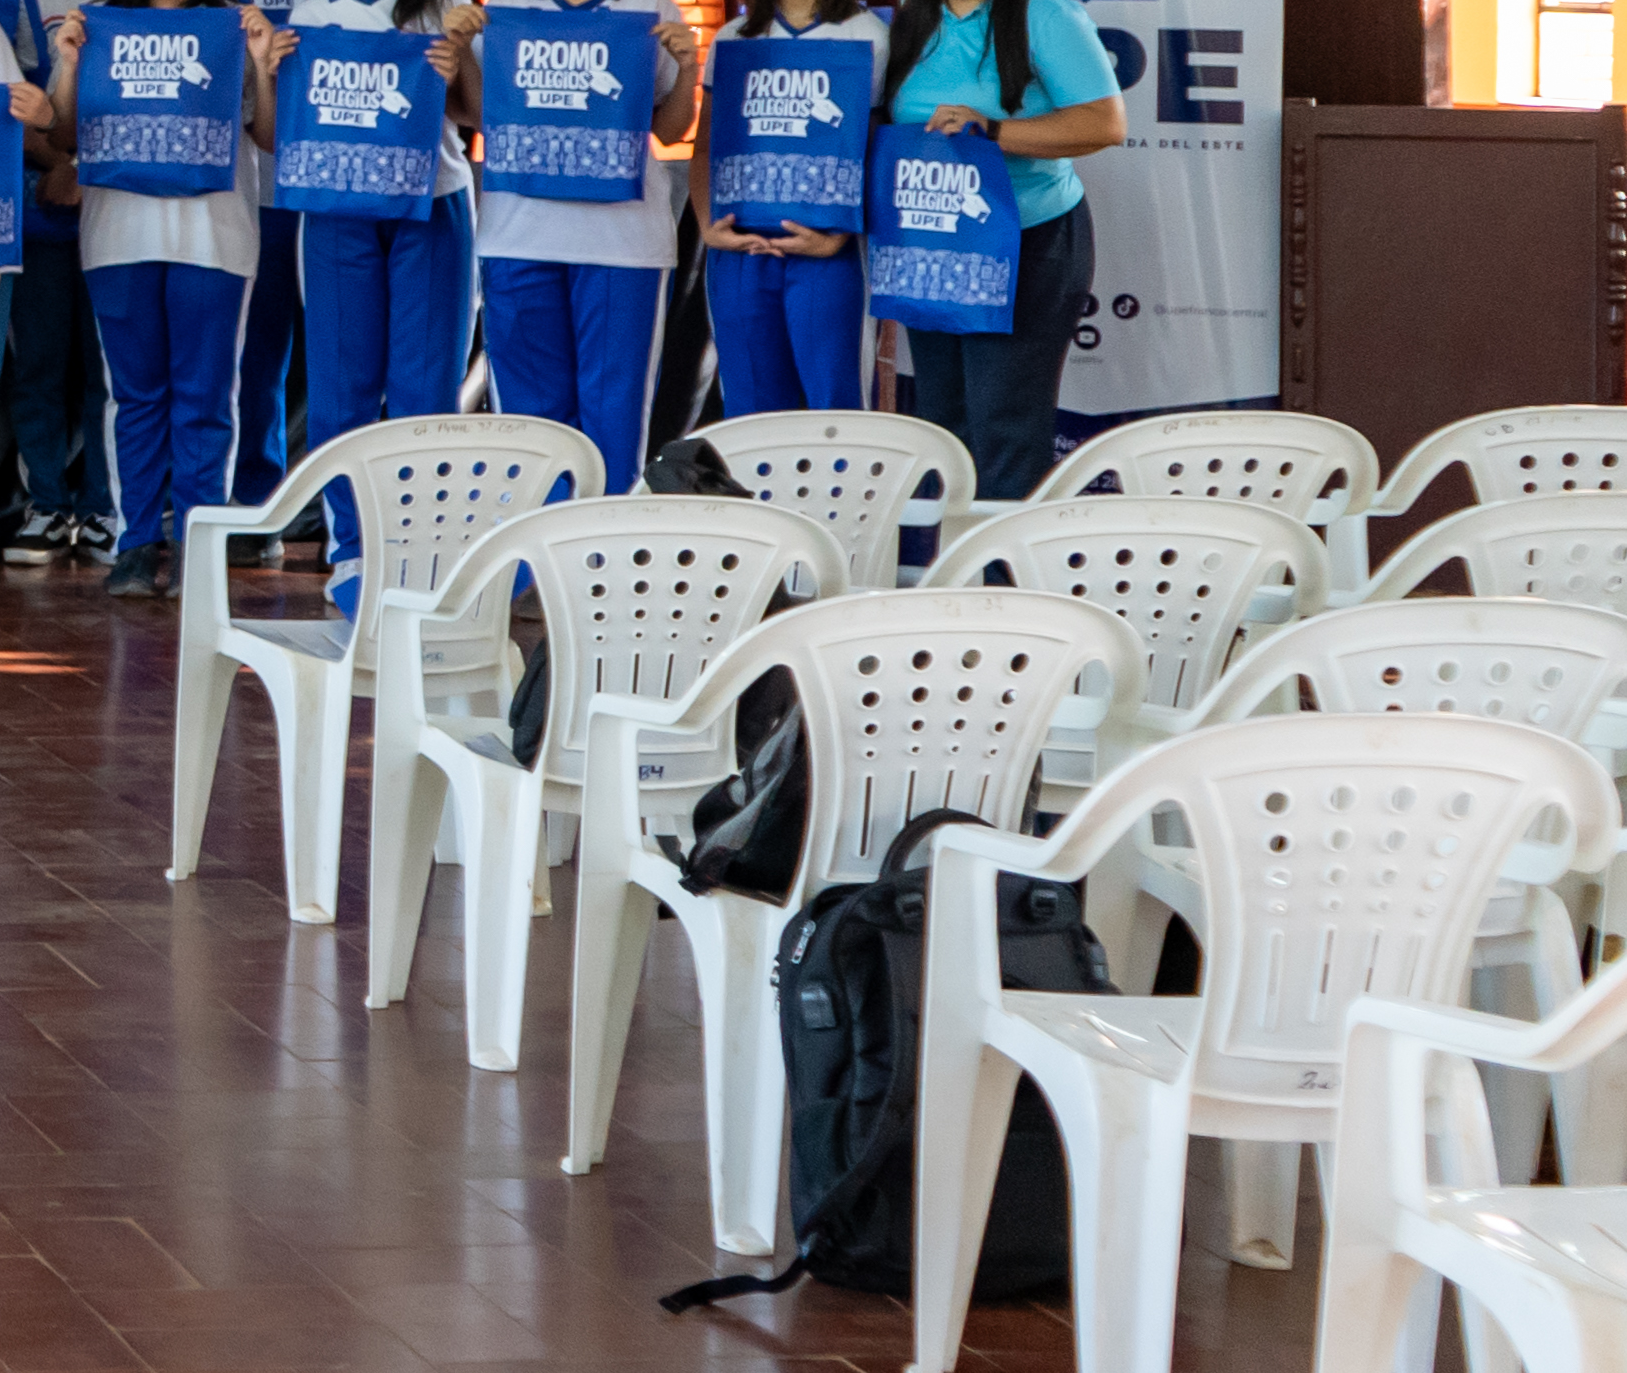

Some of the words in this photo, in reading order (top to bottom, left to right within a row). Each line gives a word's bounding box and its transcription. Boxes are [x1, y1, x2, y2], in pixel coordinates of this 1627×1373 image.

[113, 34, 200, 63] PROMO
[518, 39, 609, 71] PROMO
[313, 59, 399, 91] PROMO
[133, 83, 167, 97] UPE
[747, 68, 831, 99] PROMO
[539, 93, 574, 106] UPE
[330, 110, 365, 124] UPE
[760, 119, 795, 134] UPE
[1159, 138, 1191, 150] DEL
[1202, 140, 1245, 151] ESTE
[895, 158, 981, 193] PROMO
[910, 213, 944, 228] UPE
